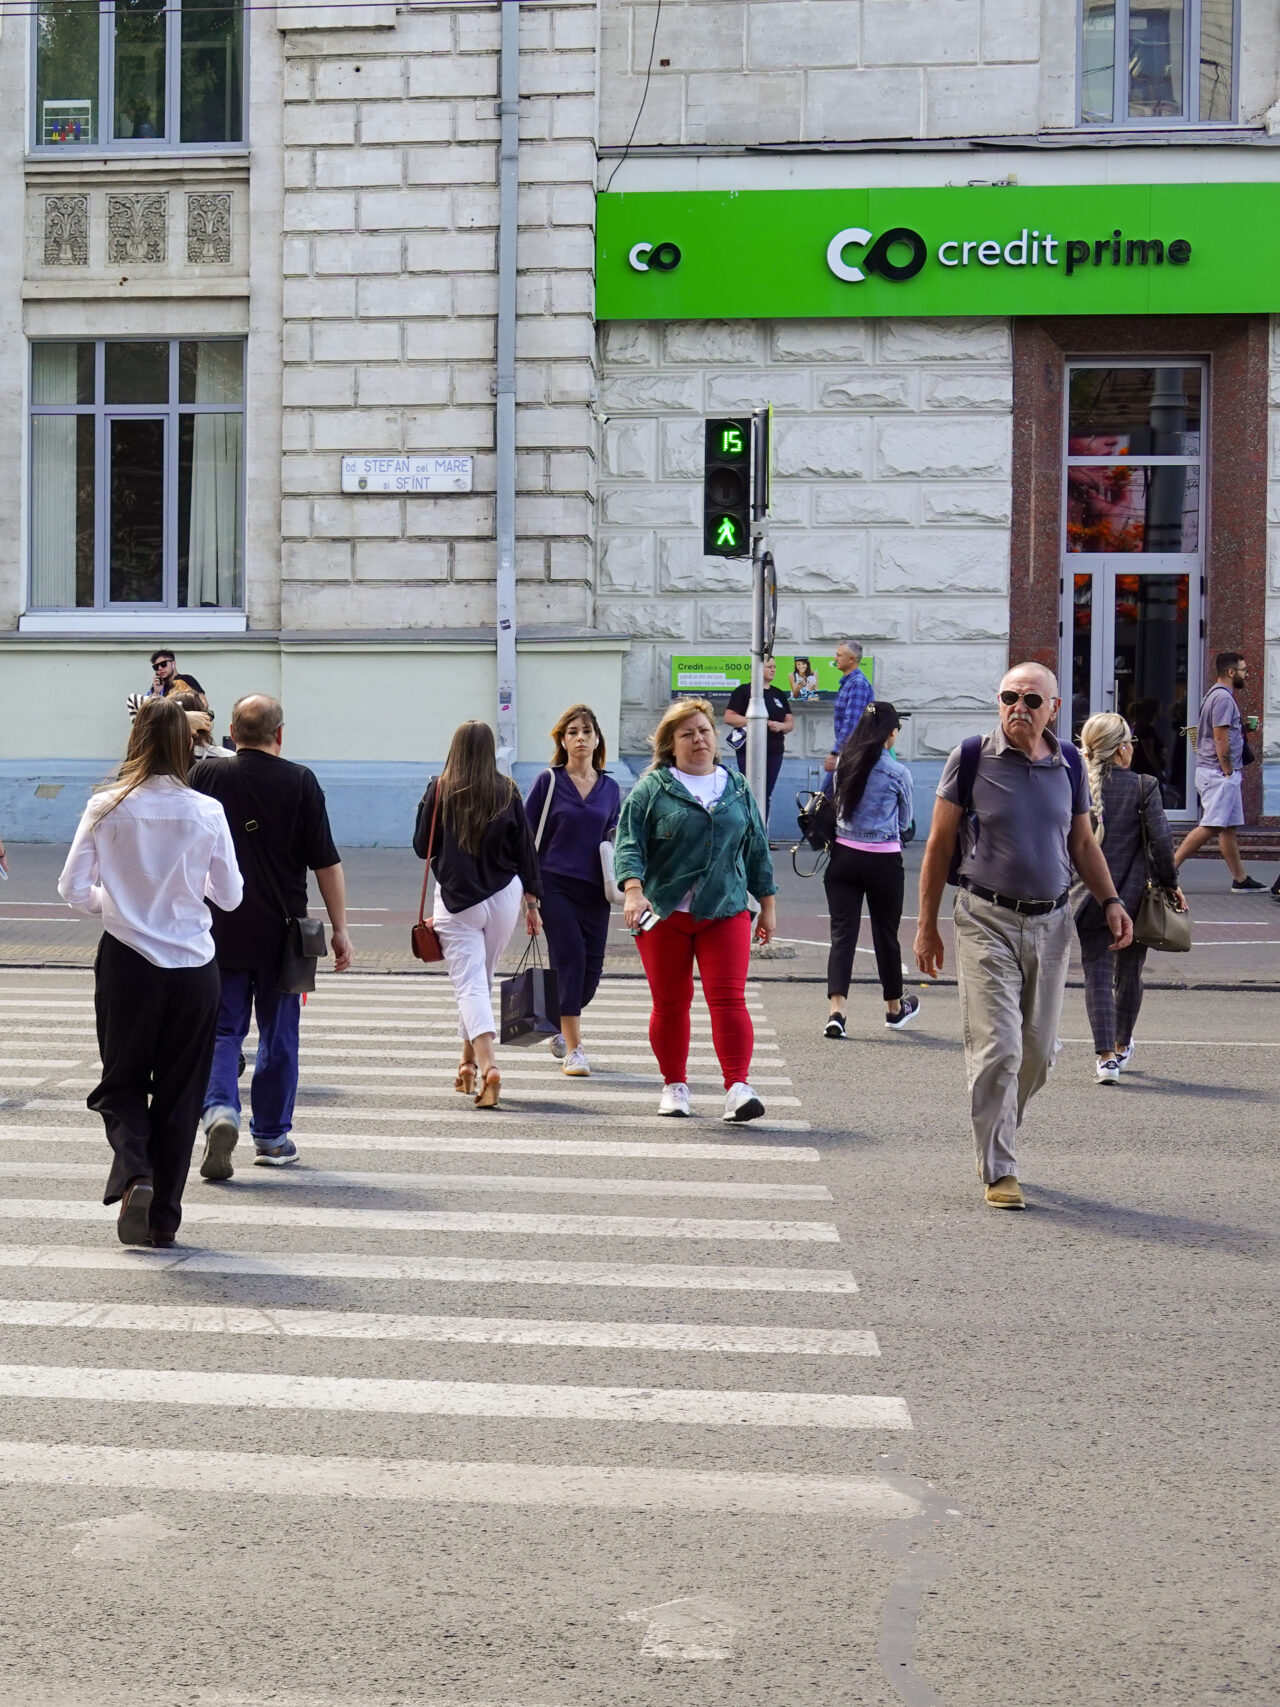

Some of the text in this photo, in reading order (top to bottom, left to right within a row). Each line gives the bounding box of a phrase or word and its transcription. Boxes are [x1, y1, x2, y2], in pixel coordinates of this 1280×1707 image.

[938, 228, 1059, 266] credit
[1066, 229, 1192, 275] prime
[723, 431, 741, 452] 15
[435, 460, 469, 472] MARE
[725, 663, 742, 671] 500
